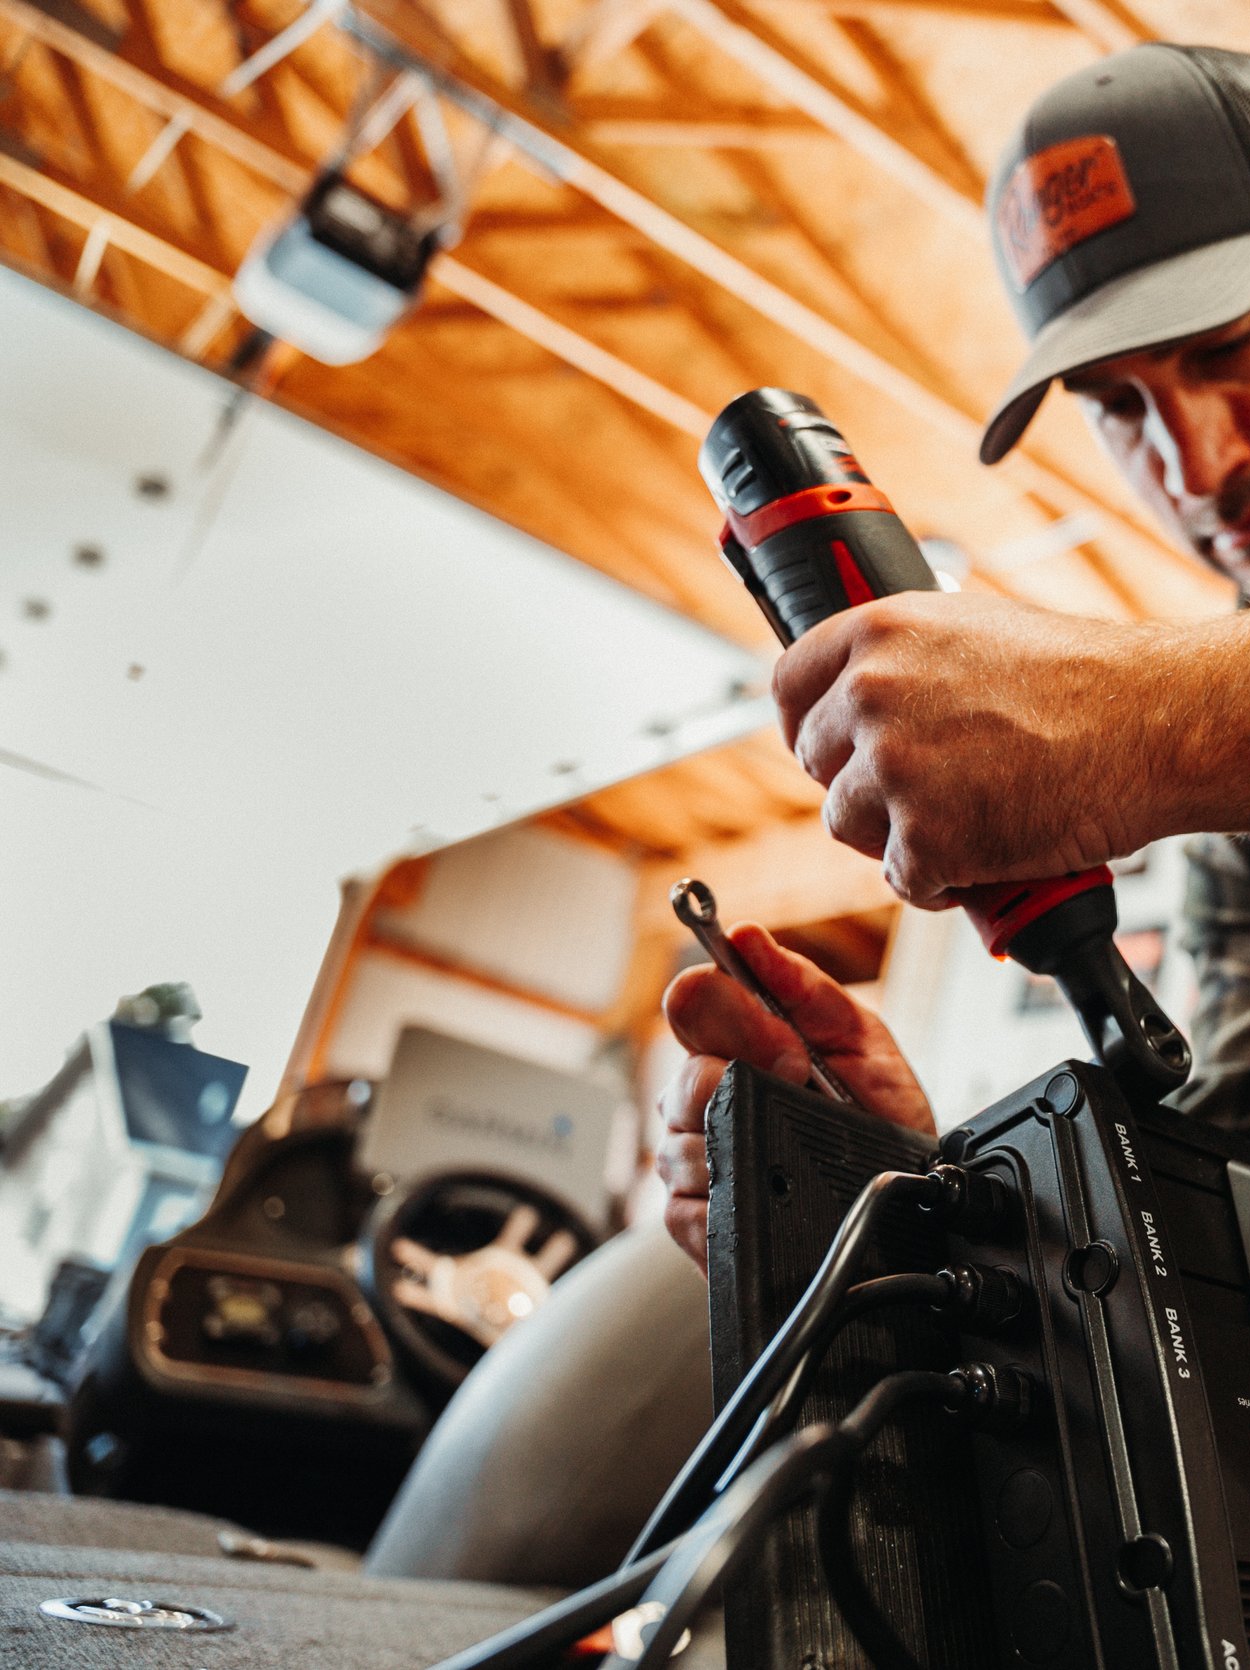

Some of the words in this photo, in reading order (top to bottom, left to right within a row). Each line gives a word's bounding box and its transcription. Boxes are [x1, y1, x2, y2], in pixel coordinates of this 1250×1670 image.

[1114, 1122, 1138, 1169] BANK
[1131, 1173, 1142, 1183] 1
[1140, 1210, 1165, 1262] BANK
[1155, 1264, 1168, 1278] 2
[1165, 1306, 1188, 1364] BANK
[1177, 1366, 1191, 1379] 3
